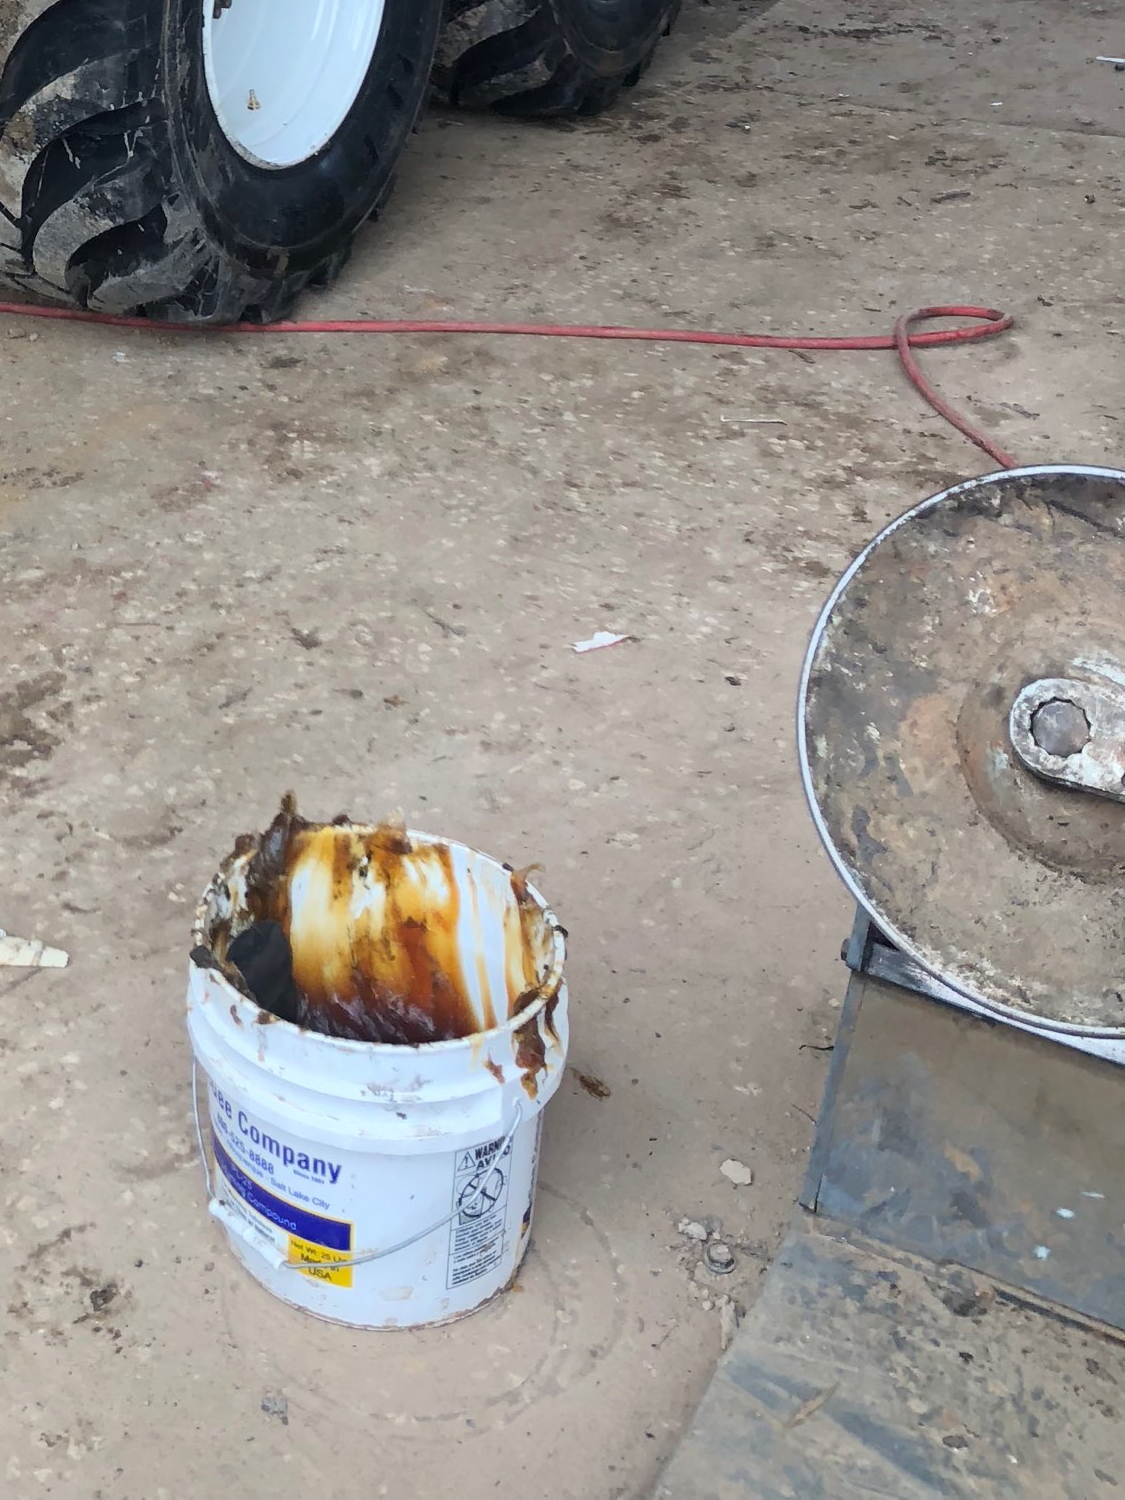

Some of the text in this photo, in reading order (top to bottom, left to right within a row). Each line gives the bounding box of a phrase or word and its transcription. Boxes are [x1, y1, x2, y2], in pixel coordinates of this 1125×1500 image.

[238, 1111, 343, 1185] Company
[477, 1145, 511, 1171] AVIO
[246, 1191, 297, 1231] Compound
[288, 1187, 310, 1202] Lake
[312, 1197, 331, 1210] City
[308, 1266, 332, 1281] USA
